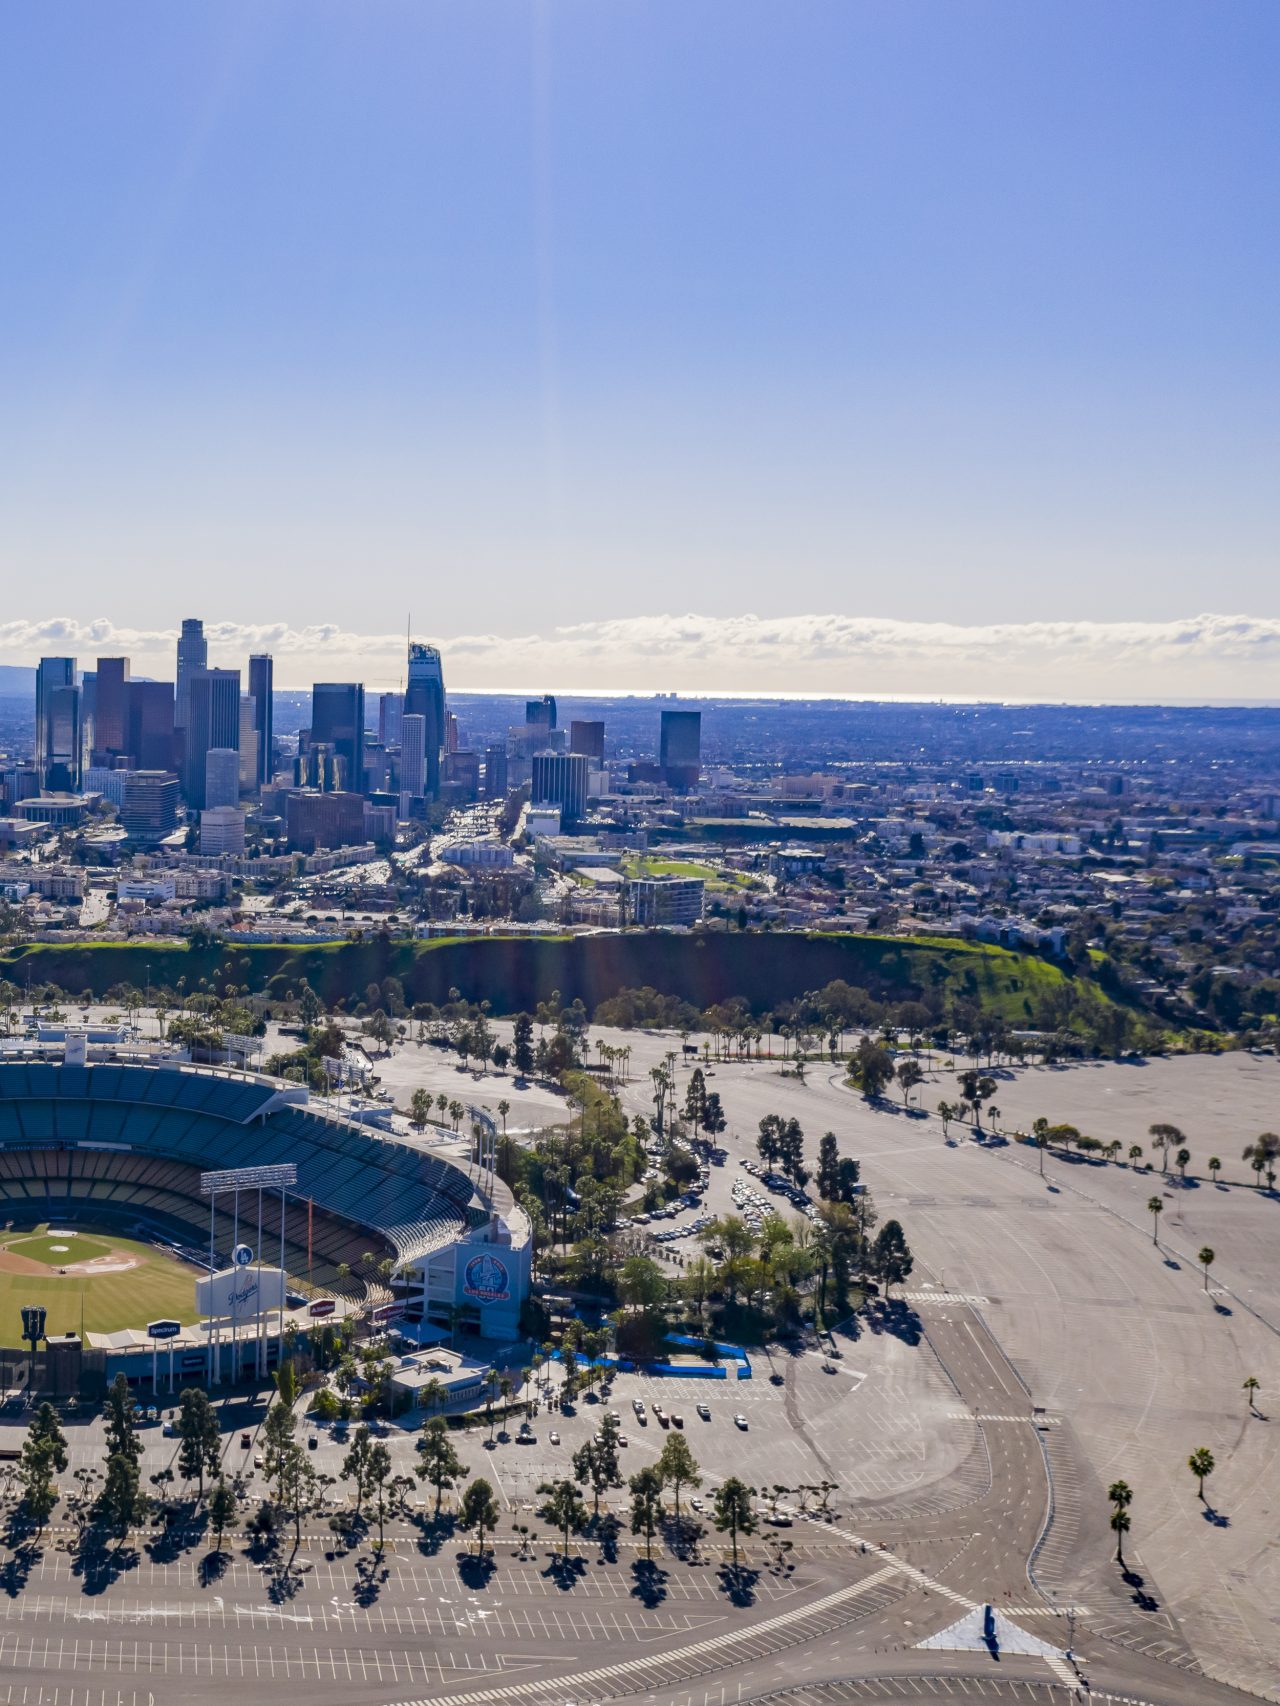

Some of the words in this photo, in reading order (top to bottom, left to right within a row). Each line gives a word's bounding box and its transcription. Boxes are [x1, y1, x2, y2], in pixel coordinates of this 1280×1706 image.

[240, 1249, 249, 1264] LA
[227, 1282, 258, 1306] Dodgers
[150, 1326, 177, 1335] Spectrum
